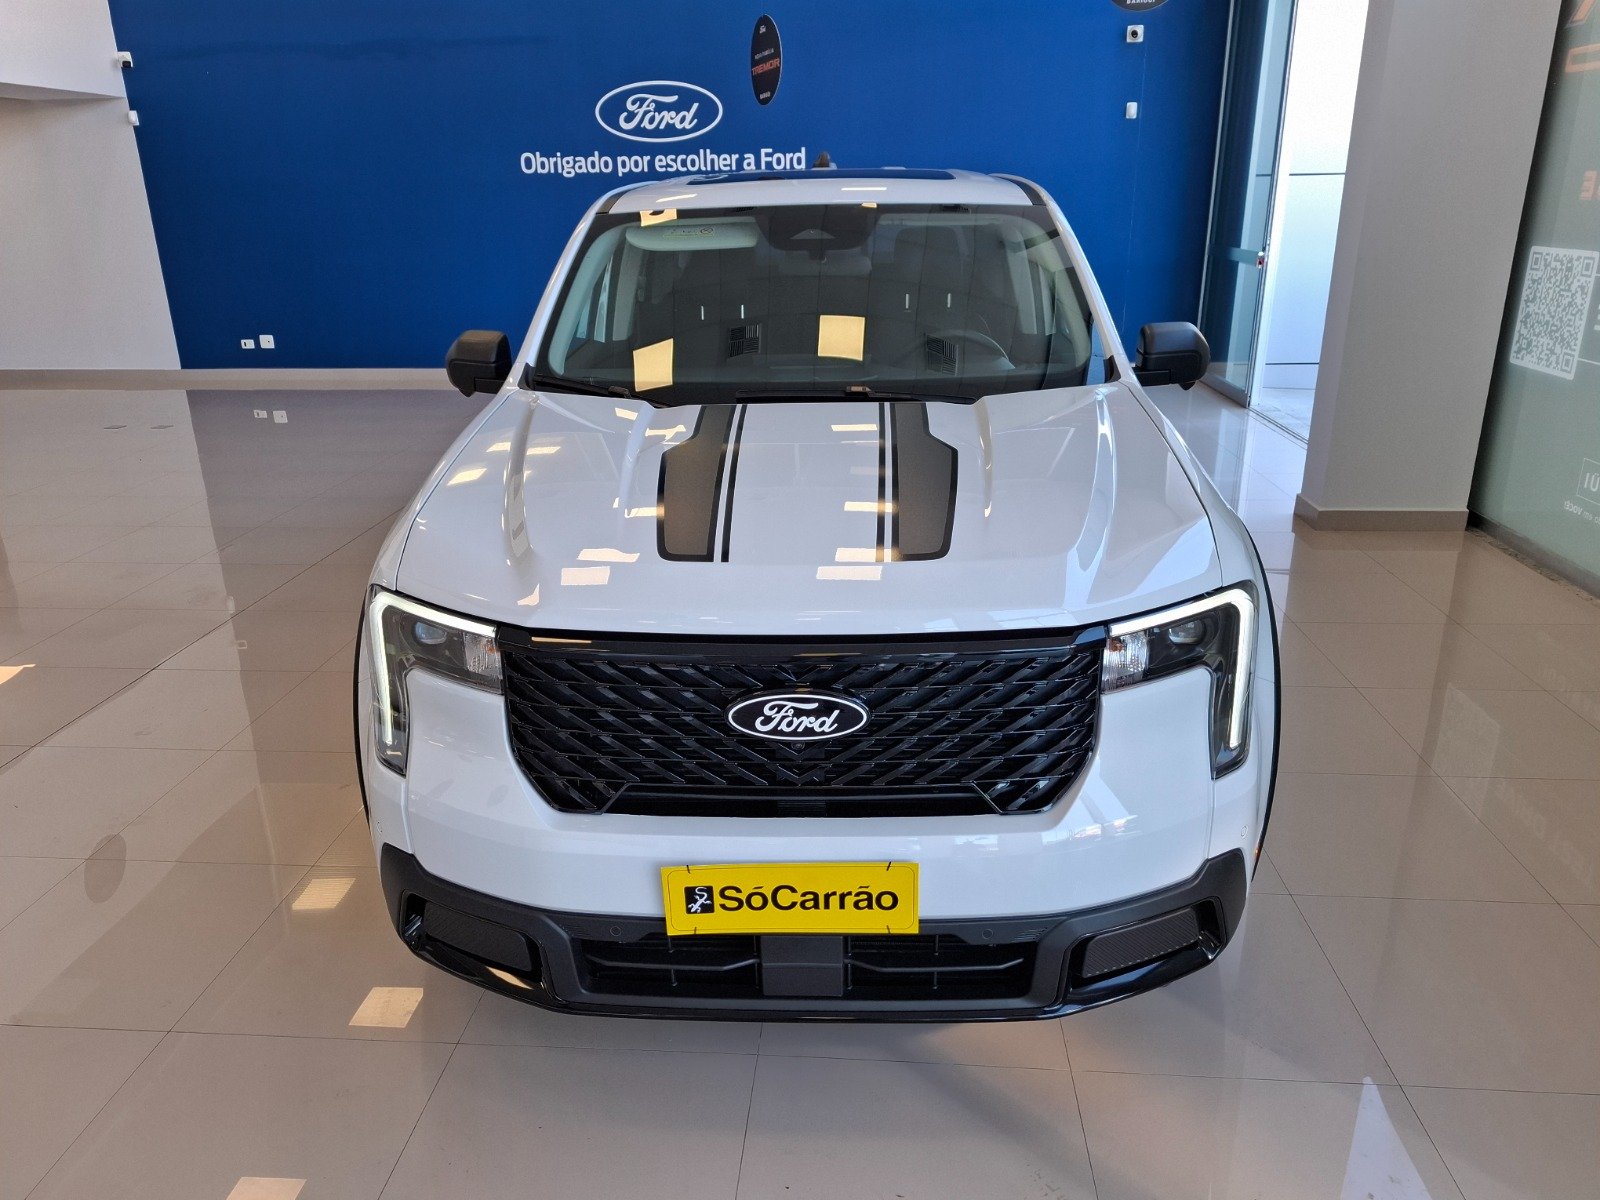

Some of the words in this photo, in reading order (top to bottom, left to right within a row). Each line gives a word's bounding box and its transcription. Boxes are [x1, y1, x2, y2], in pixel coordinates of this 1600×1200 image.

[752, 58, 780, 76] TREMOR
[618, 93, 699, 130] Ford
[520, 151, 613, 177] Obrigado
[616, 155, 651, 177] por
[654, 149, 739, 173] escolher
[743, 153, 756, 171] a
[761, 147, 806, 171] Ford
[754, 700, 840, 733] Ford
[718, 884, 899, 912] SóCarrão
